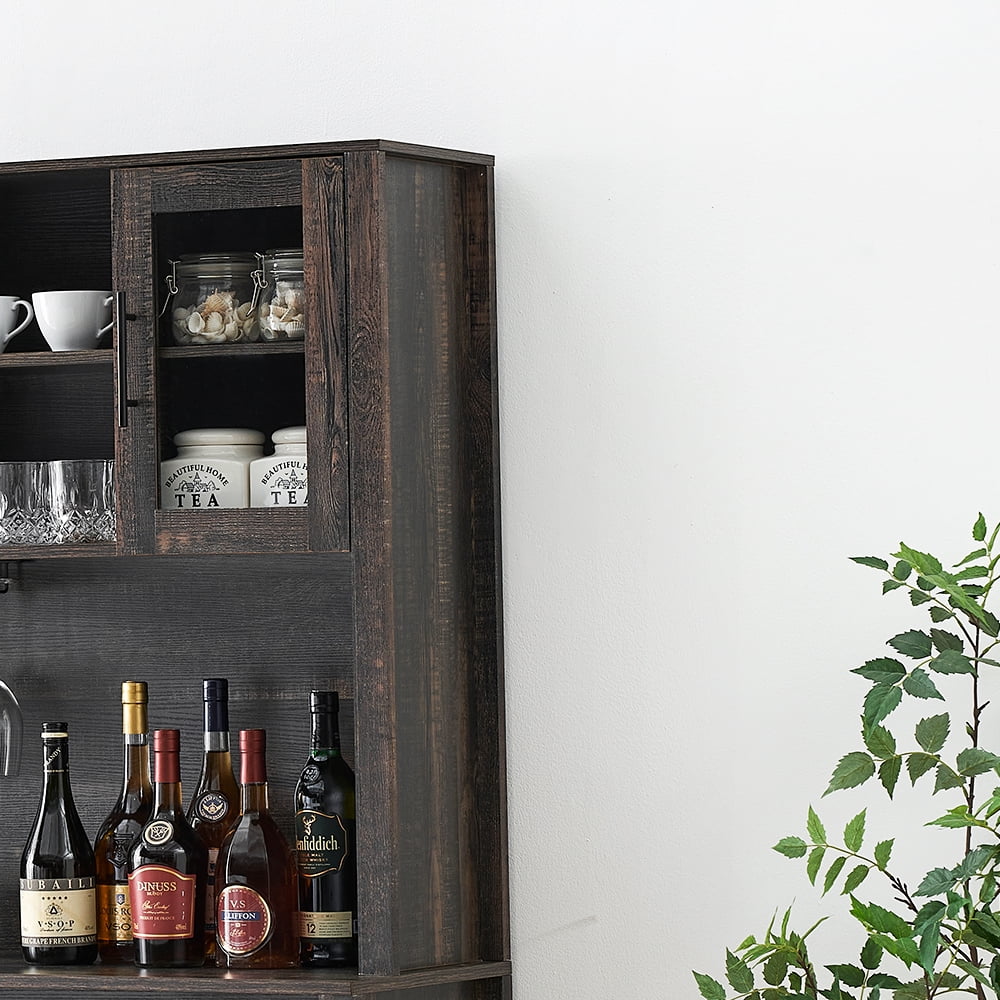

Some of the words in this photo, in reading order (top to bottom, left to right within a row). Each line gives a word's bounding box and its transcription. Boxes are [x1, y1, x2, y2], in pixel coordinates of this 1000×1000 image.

[165, 464, 205, 488] BEAUTIFUL
[206, 466, 230, 487] HOME
[261, 461, 301, 485] BEAUTIFUL
[174, 493, 220, 508] TEA
[137, 881, 177, 892] DINUSS
[230, 900, 246, 908] V.S
[306, 923, 316, 934] 12
[48, 936, 76, 945] FRENCH
